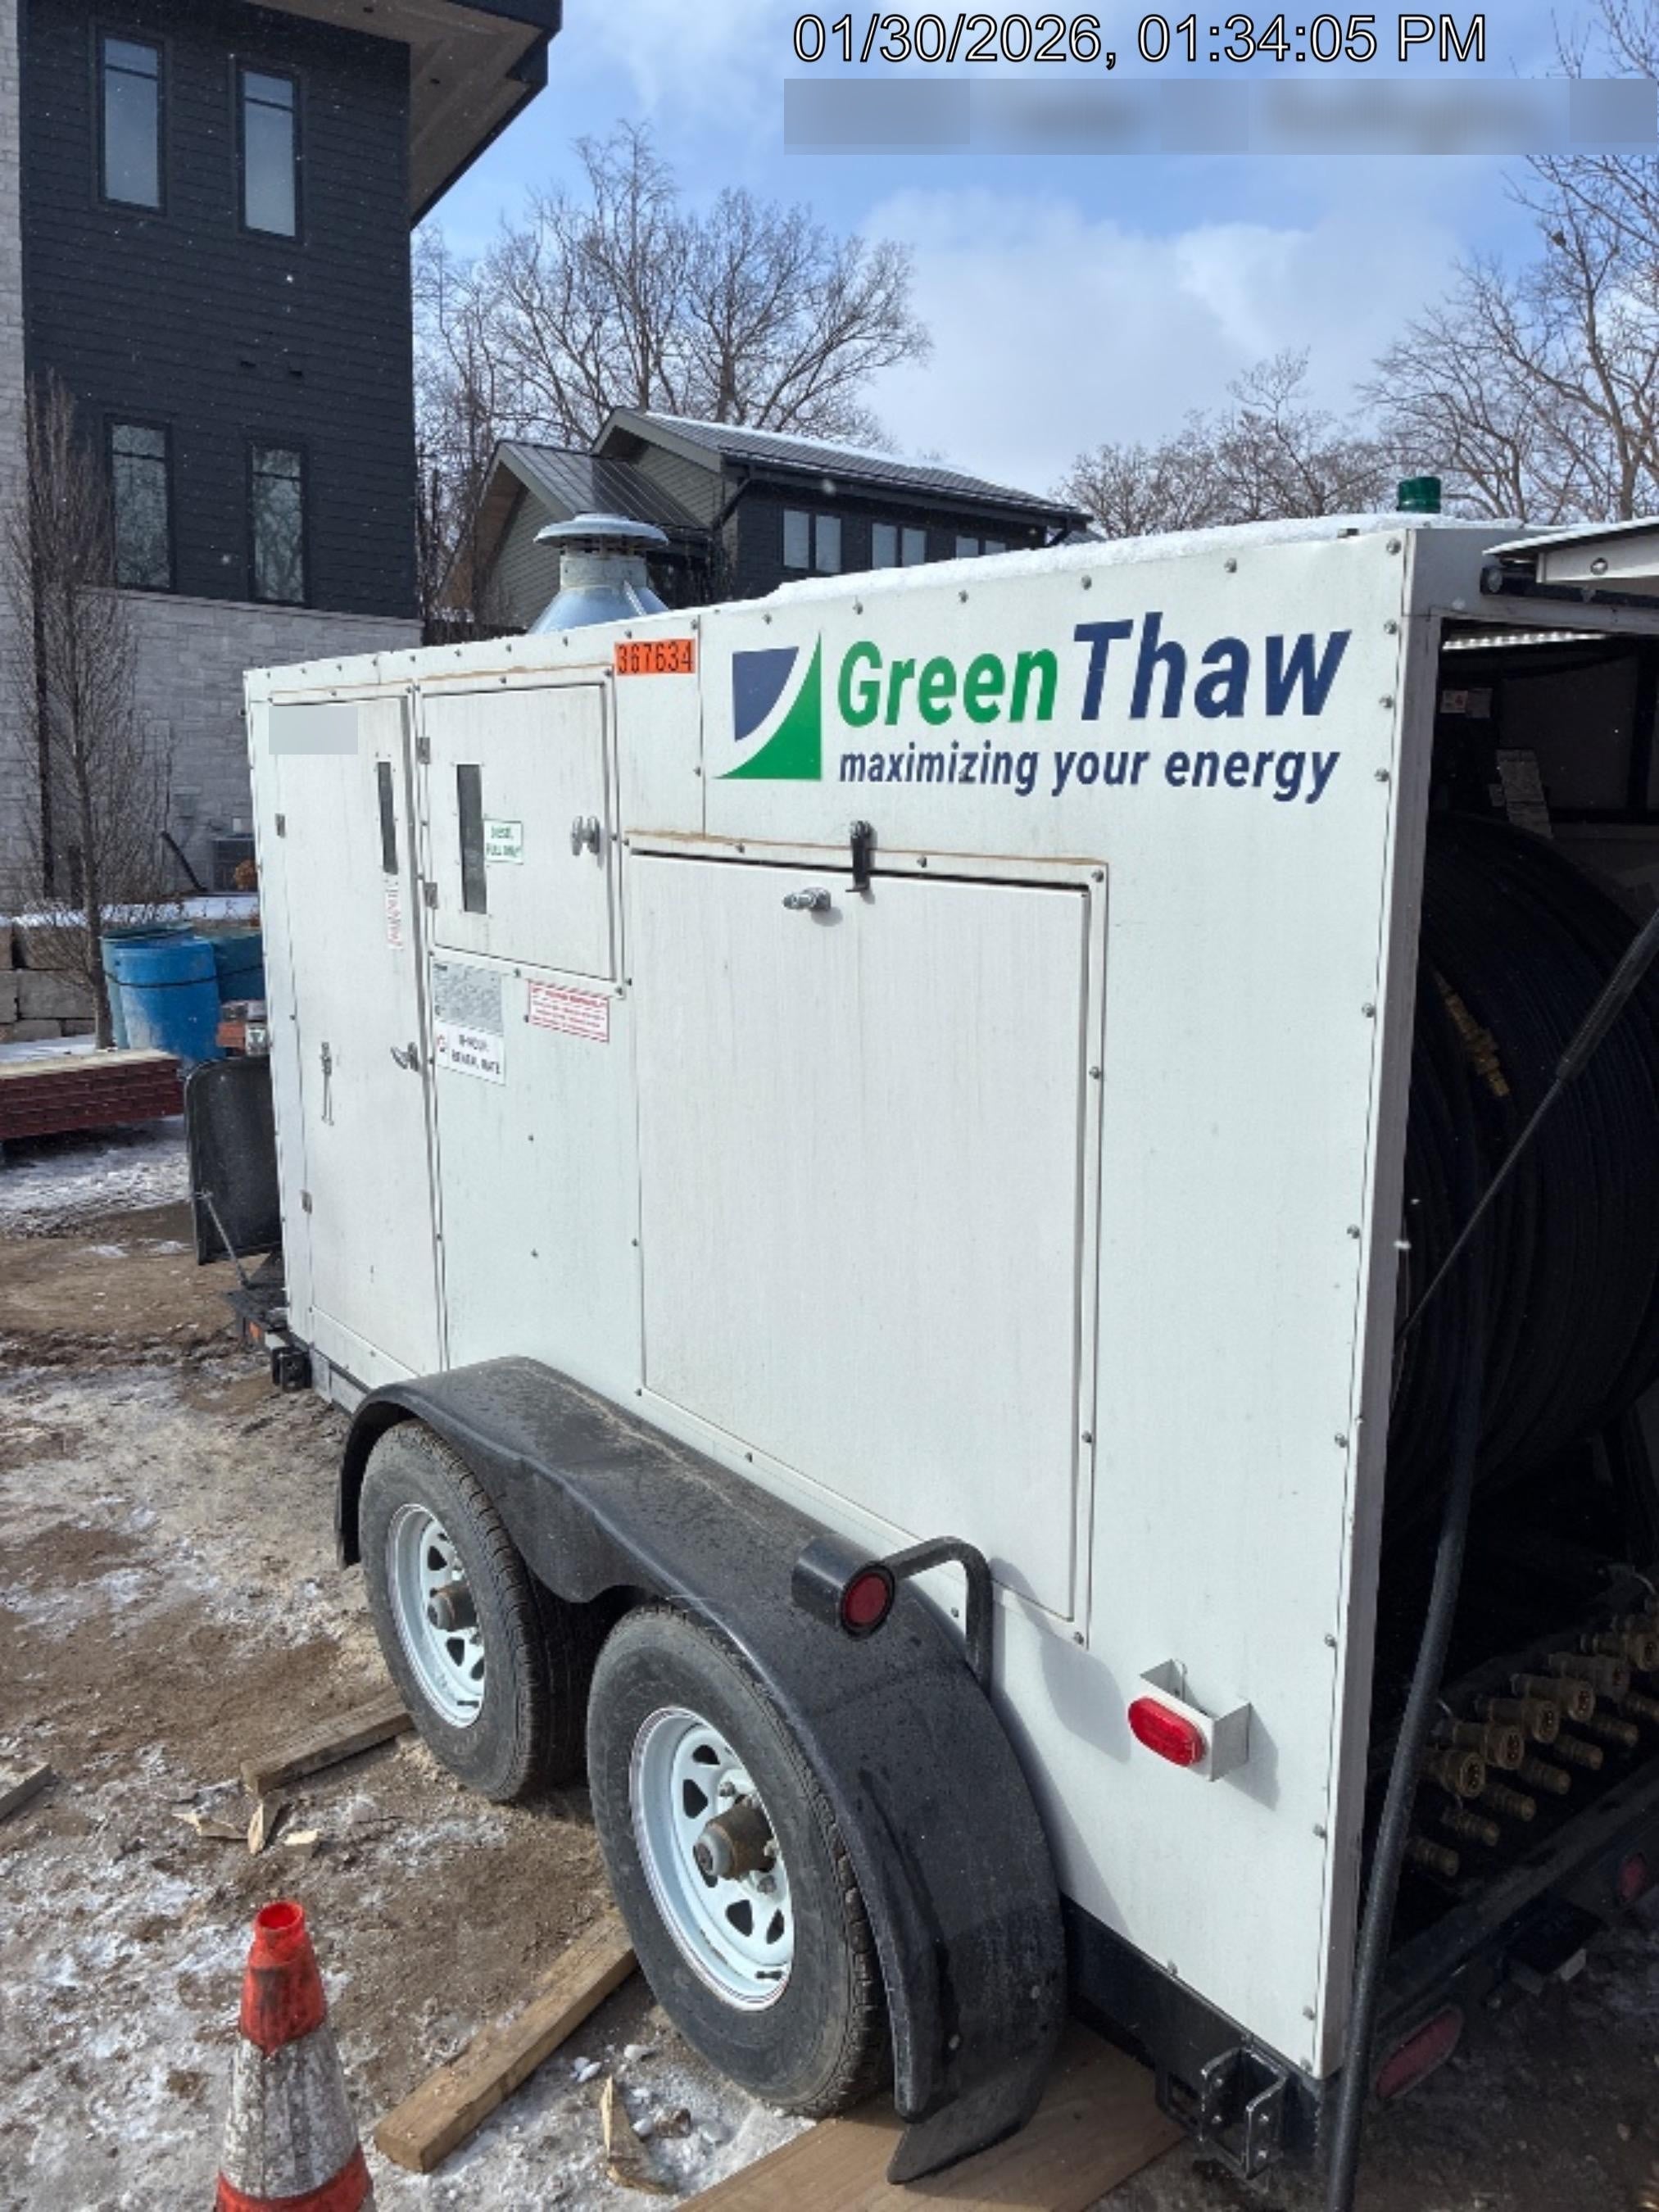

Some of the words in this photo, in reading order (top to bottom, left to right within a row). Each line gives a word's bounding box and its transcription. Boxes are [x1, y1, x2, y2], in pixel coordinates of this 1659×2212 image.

[619, 641, 692, 673] 367634
[839, 739, 1040, 797] maximizing
[1051, 750, 1151, 798] your
[1164, 750, 1341, 805] energy
